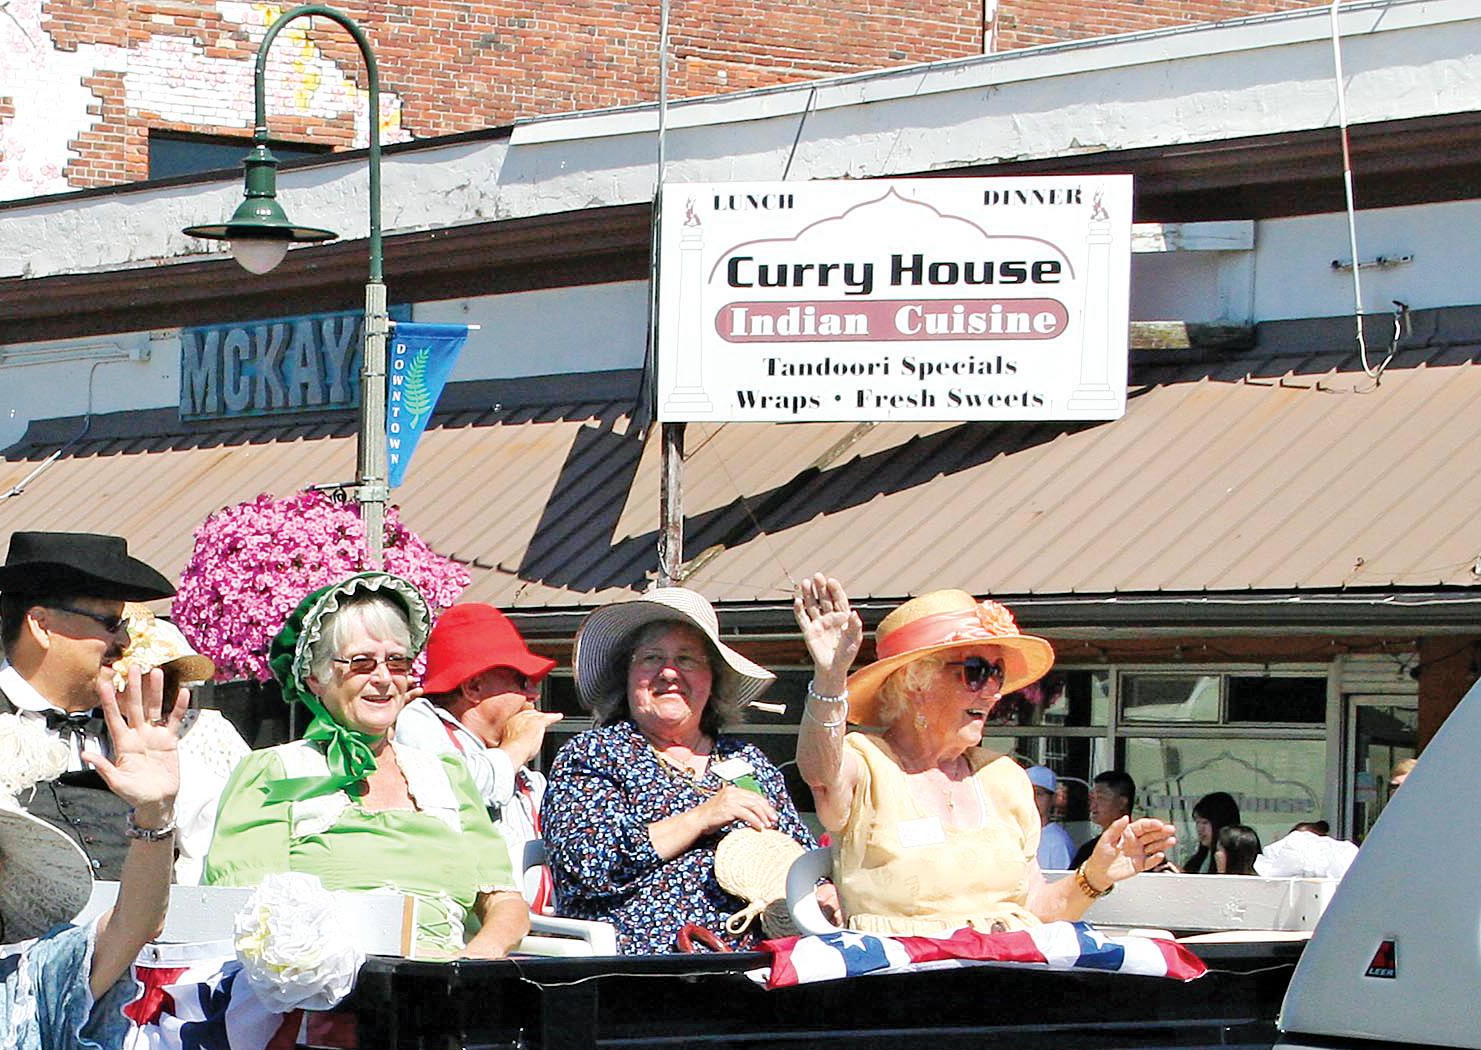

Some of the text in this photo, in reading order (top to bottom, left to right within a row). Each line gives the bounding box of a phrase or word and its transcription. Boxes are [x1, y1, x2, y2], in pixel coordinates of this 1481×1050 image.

[713, 188, 1083, 211] LUNCH DINNER
[727, 253, 1062, 295] Curry House
[729, 304, 1059, 337] Indian Cuisine
[180, 316, 363, 415] MCKAY
[762, 355, 1018, 381] Tandoori Specials
[389, 343, 407, 465] DOWNTOWN
[736, 387, 1045, 414] Wraps Fresh Sweets
